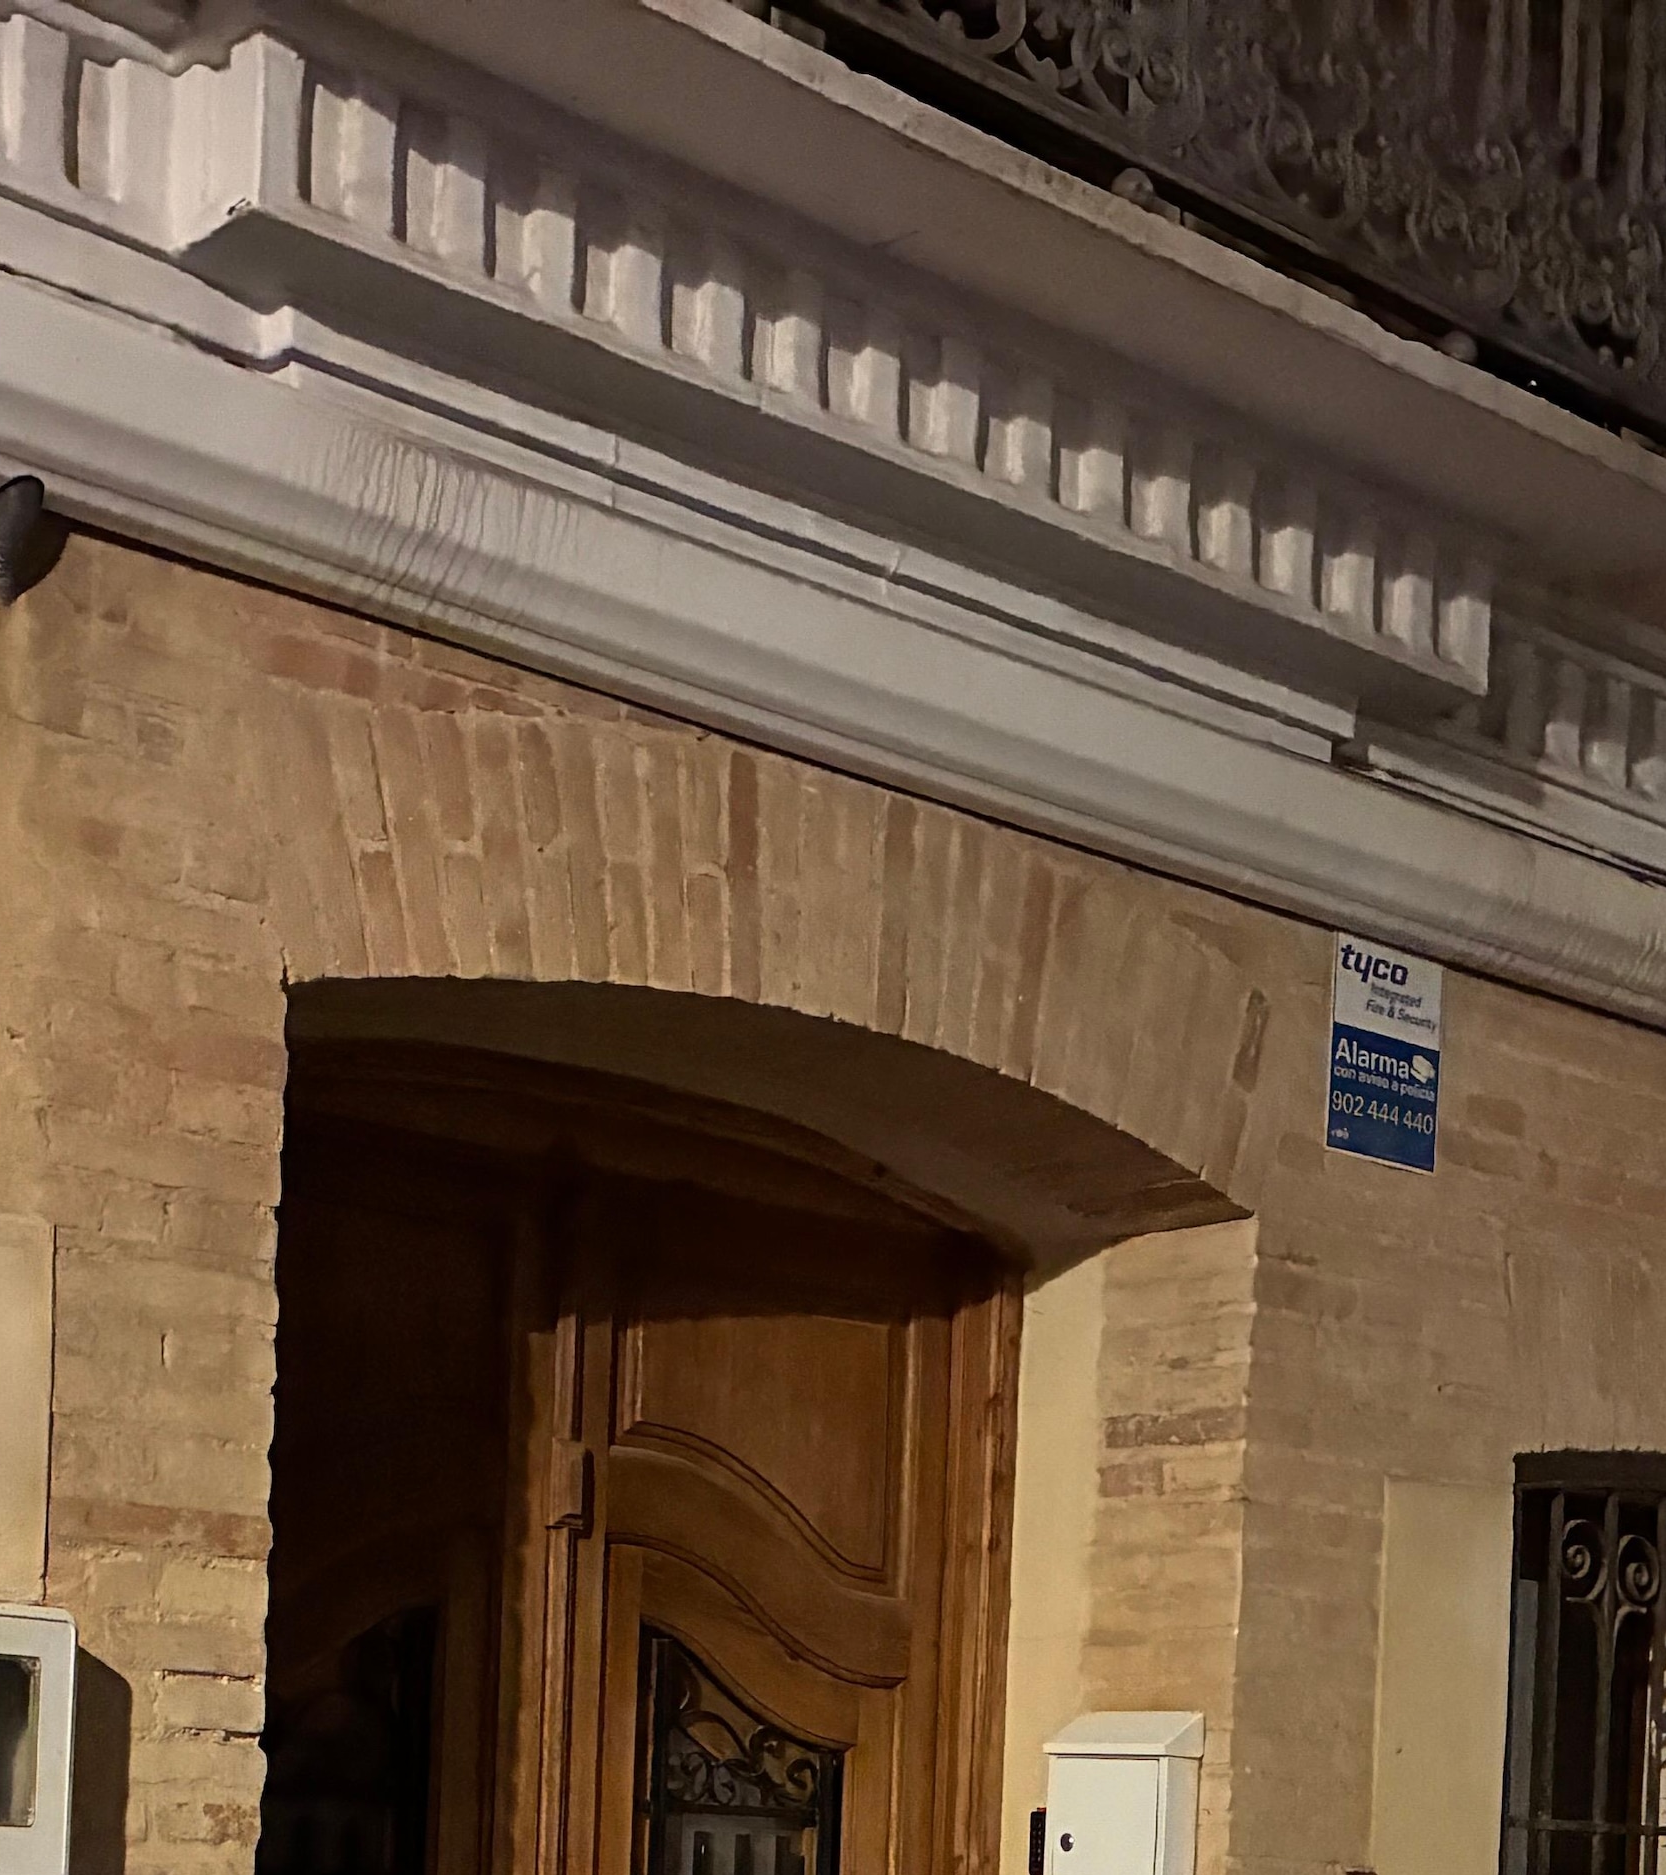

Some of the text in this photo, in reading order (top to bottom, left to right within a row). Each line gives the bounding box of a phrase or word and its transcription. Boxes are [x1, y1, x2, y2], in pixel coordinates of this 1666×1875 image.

[1341, 944, 1408, 985] tyco
[1387, 1005, 1395, 1018] &
[1397, 1008, 1437, 1033] Security
[1334, 1066, 1356, 1080] con
[1358, 1071, 1389, 1089] aviso
[1391, 1080, 1399, 1091] a
[1335, 1038, 1409, 1080] Alarma
[1332, 1090, 1433, 1135] 902 444 440
